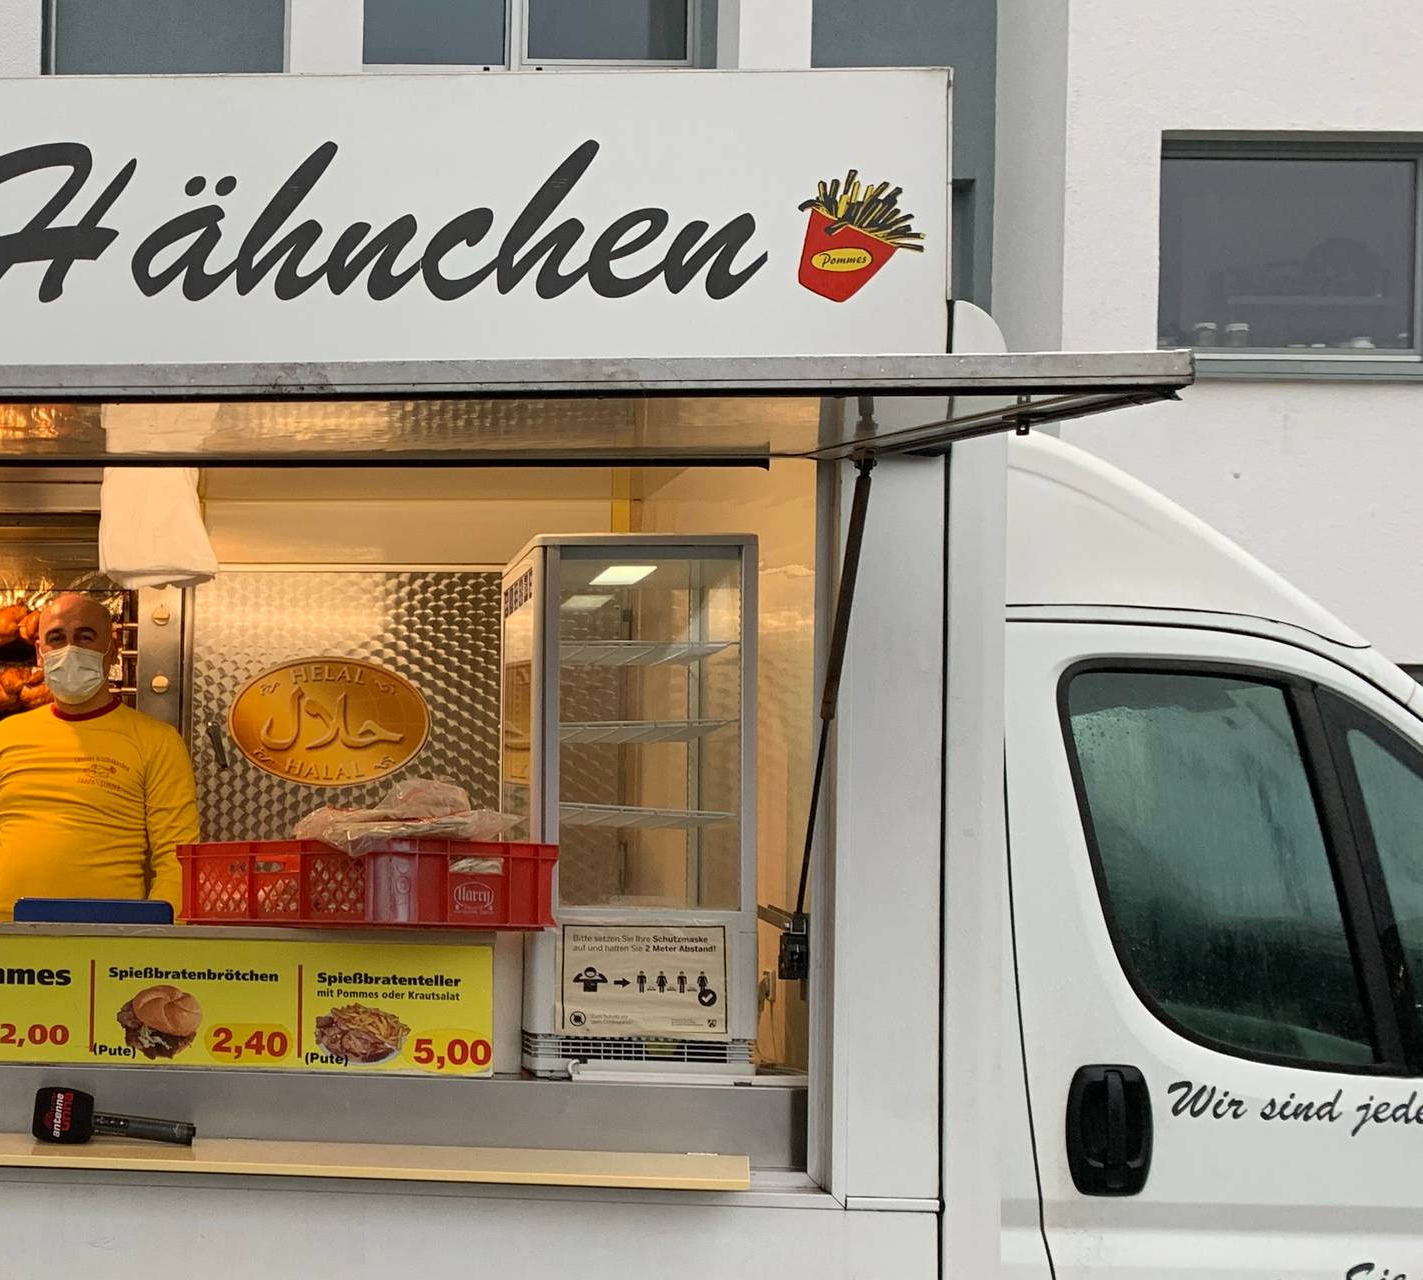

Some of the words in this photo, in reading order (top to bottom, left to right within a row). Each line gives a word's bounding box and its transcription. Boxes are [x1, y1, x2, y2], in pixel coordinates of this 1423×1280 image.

[819, 252, 867, 268] Pommes
[291, 665, 367, 686] HELAL
[260, 685, 405, 752] حلال
[284, 757, 366, 781] HALAL
[653, 935, 709, 944] Schutzmaske
[652, 945, 677, 953] Meter
[679, 945, 717, 954] Abstand!
[108, 966, 279, 984] Spießbratenbrötchen
[316, 971, 462, 989] Spießbratenteller
[316, 988, 334, 999] mit
[337, 989, 379, 1000] Pommes
[382, 990, 405, 1001] oder
[408, 990, 461, 1002] Krautsalat
[0, 1022, 71, 1048] 2,00
[212, 1026, 288, 1059] 2,40
[93, 1043, 137, 1060] (Pute)
[305, 1051, 350, 1068] (Pute)
[413, 1037, 493, 1071] 5,00
[1167, 1080, 1249, 1120] Wir
[1259, 1088, 1344, 1123] sind
